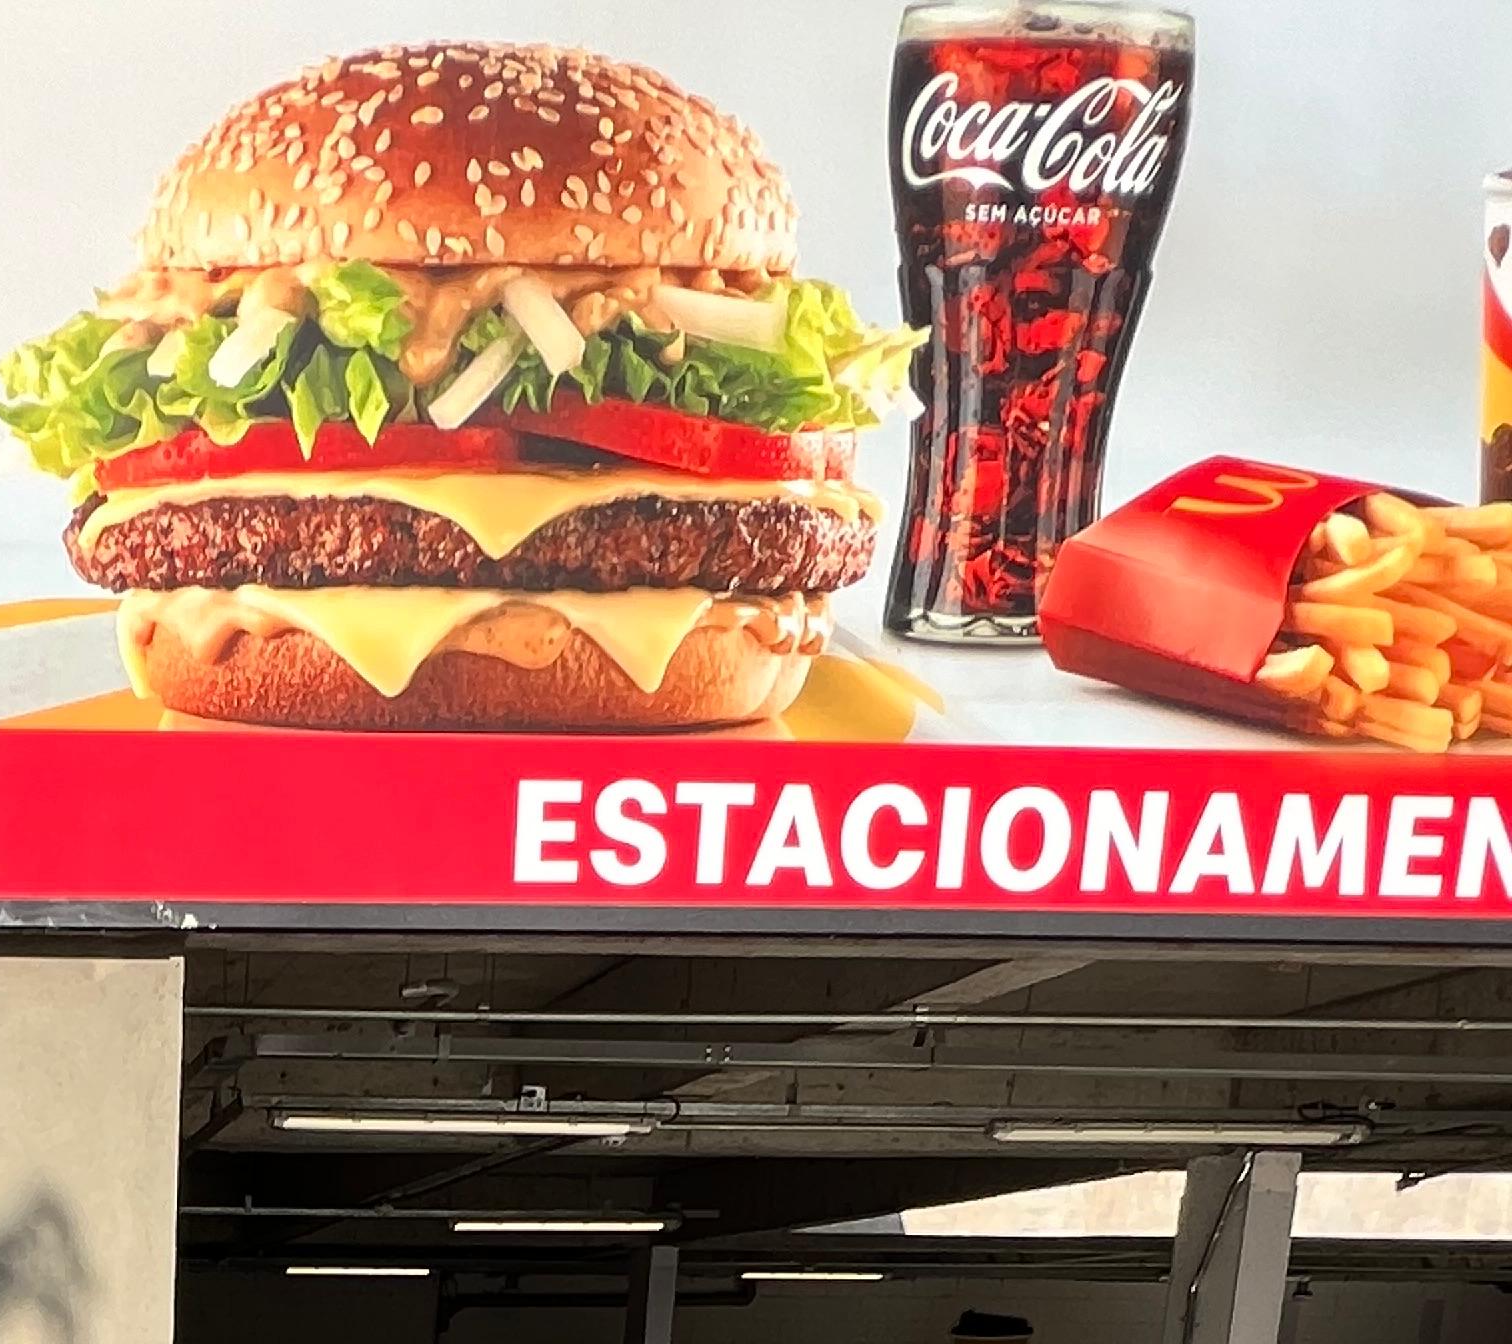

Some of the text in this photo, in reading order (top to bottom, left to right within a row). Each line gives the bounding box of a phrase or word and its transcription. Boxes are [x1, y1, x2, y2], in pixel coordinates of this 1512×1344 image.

[901, 71, 1184, 195] Coca-Cola
[964, 202, 1102, 227] SEM AÇÚCAR
